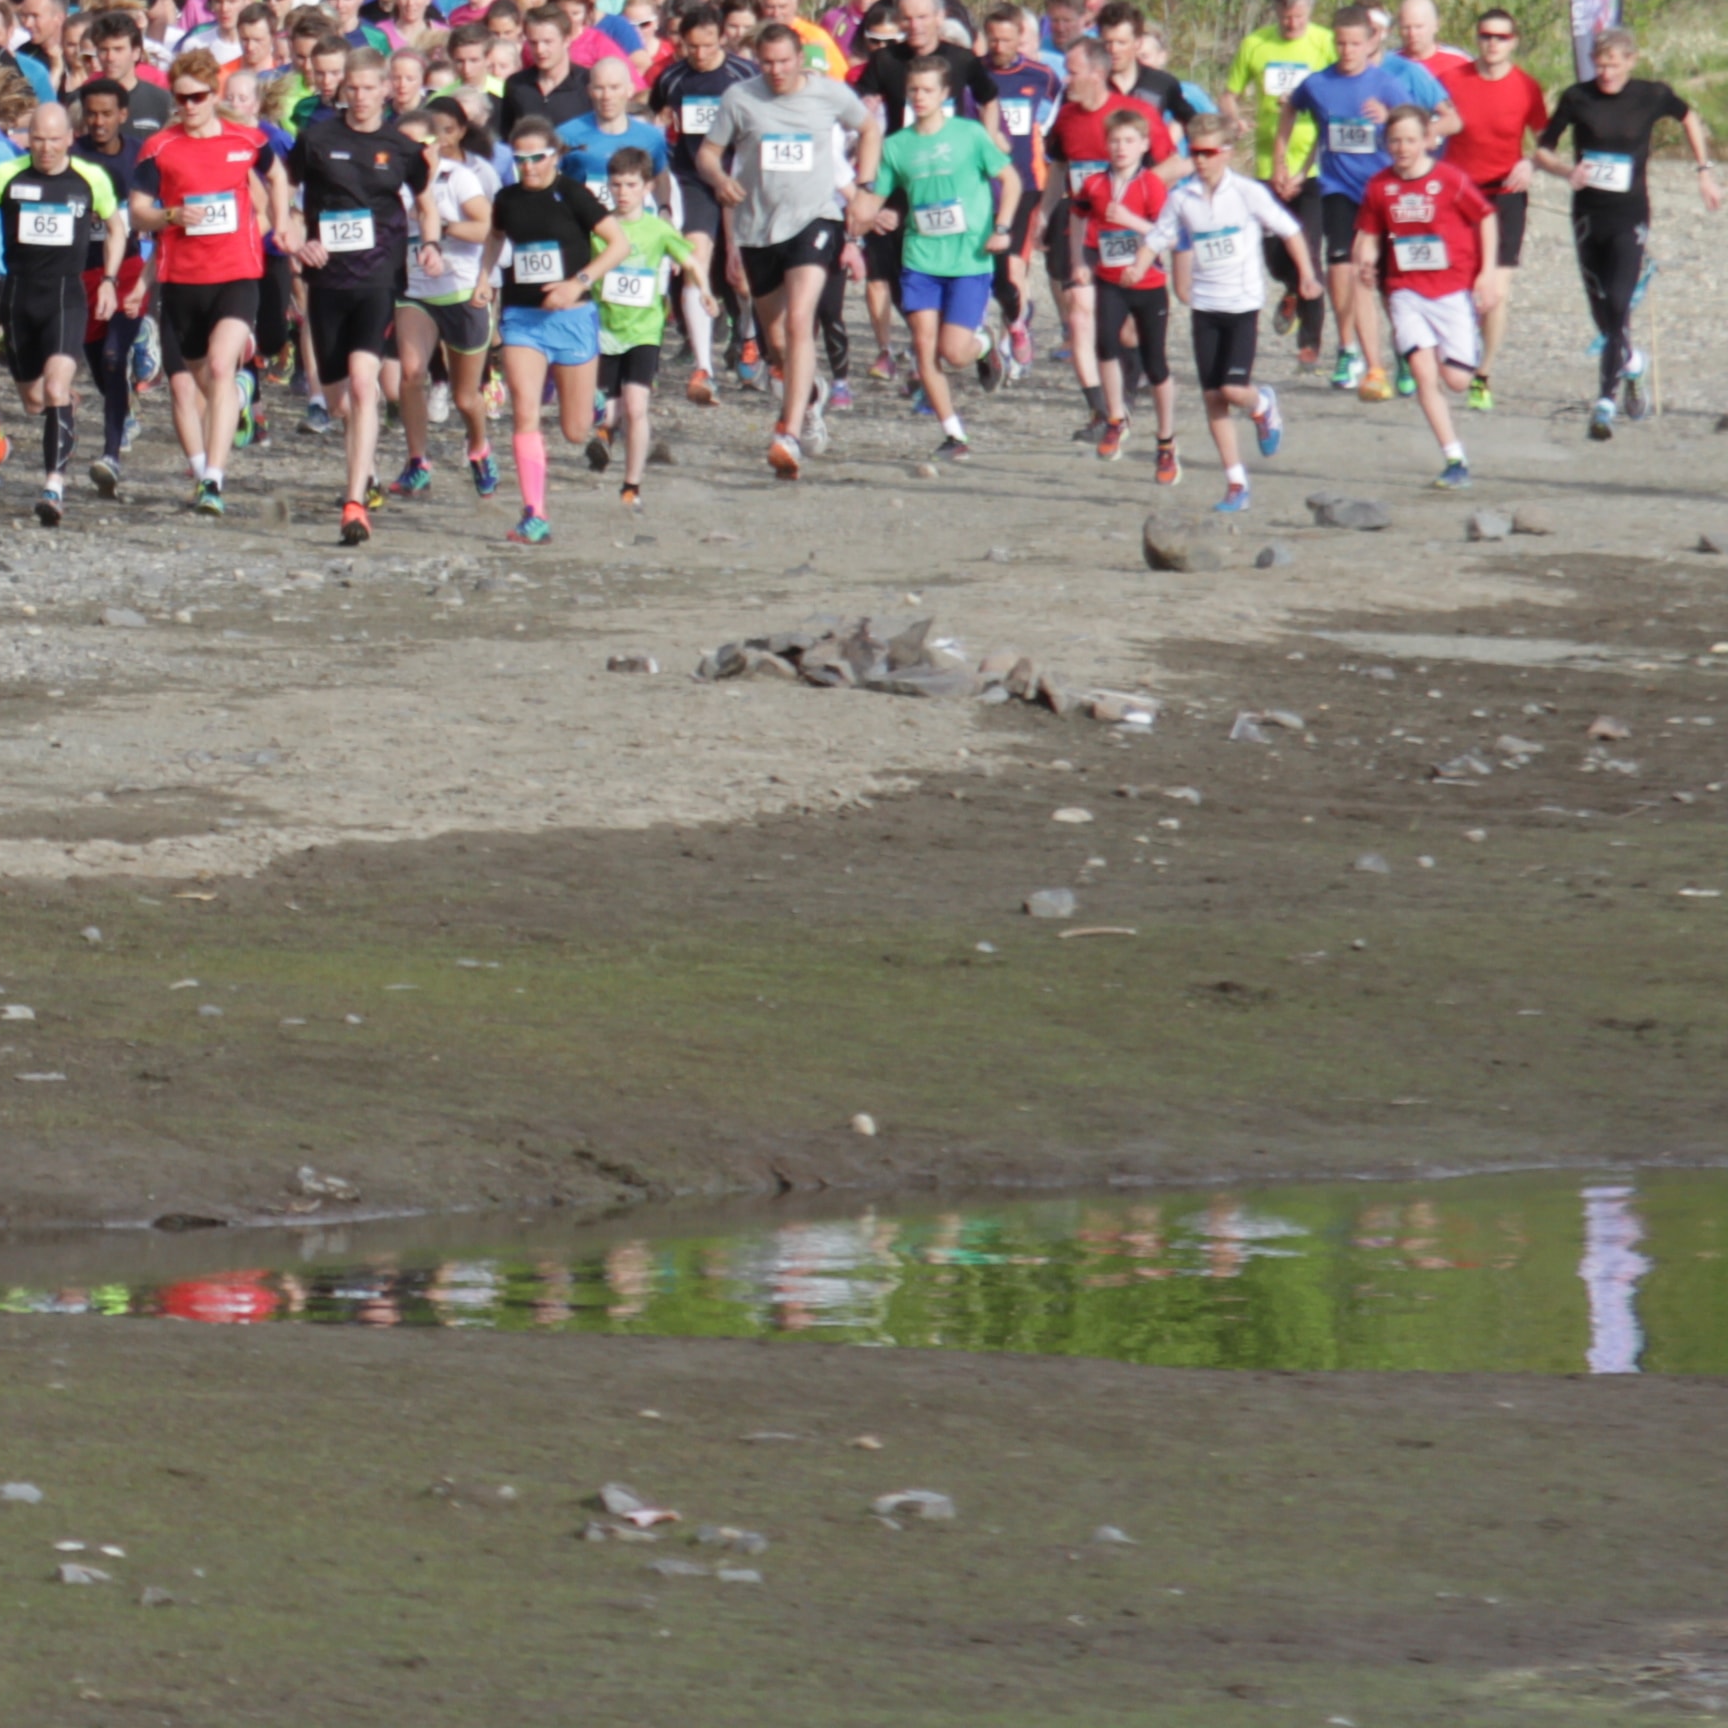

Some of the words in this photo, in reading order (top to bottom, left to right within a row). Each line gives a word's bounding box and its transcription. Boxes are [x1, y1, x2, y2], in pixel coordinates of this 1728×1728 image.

[1336, 127, 1367, 145] 149
[772, 143, 804, 162] 143
[33, 215, 59, 234] 65
[924, 209, 956, 227] 173
[330, 220, 365, 240] 125
[1104, 239, 1138, 258] 238
[1203, 239, 1235, 261] 118
[1408, 244, 1432, 262] 99
[521, 252, 553, 273] 160
[617, 276, 642, 296] 90
